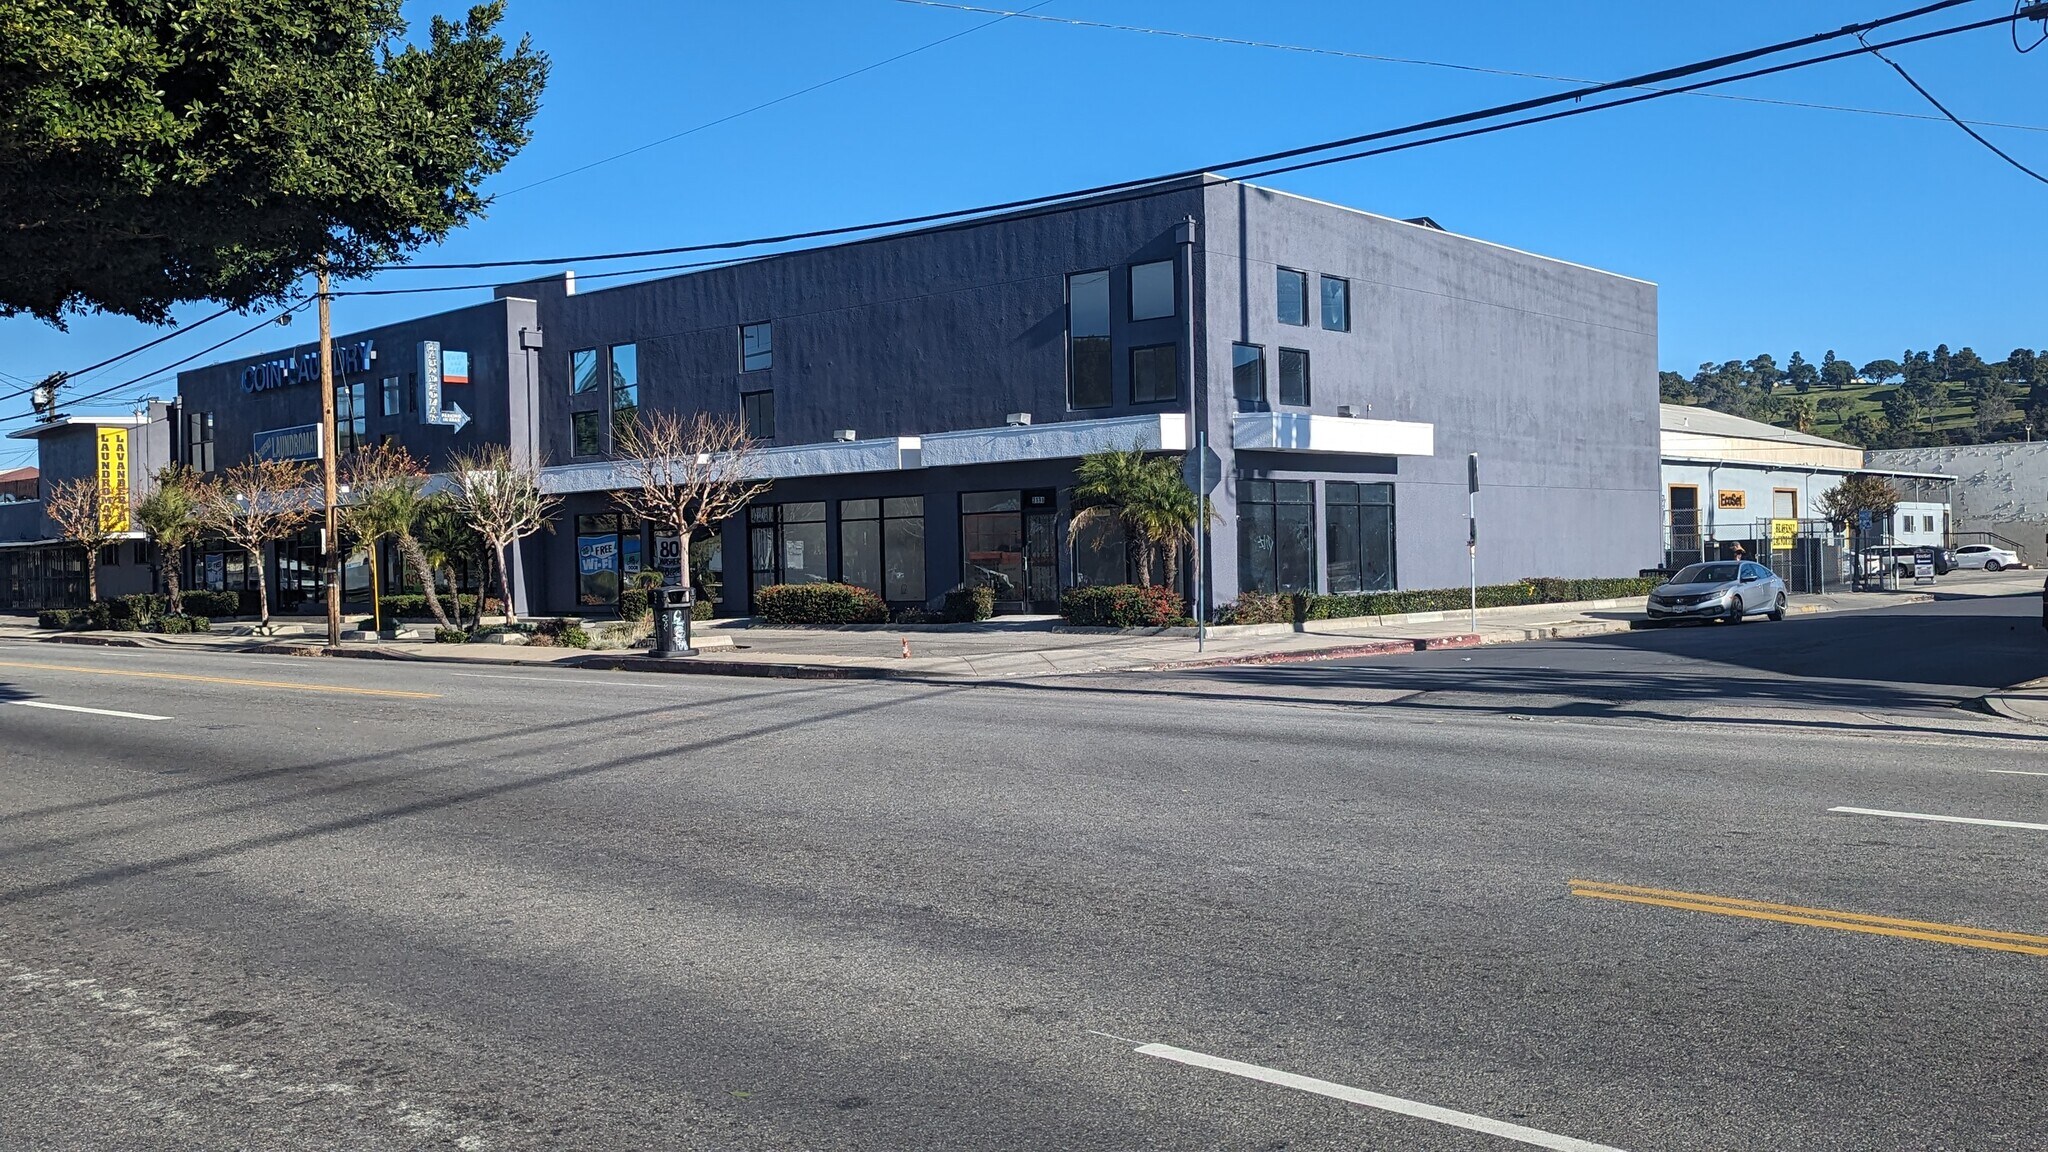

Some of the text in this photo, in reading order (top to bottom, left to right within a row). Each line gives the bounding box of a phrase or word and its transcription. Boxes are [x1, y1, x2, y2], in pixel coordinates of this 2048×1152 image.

[241, 340, 374, 393] COIN LAUDRY
[271, 432, 319, 459] LAUNDROMAT
[1721, 493, 1742, 506] EcoSet
[595, 545, 613, 556] FREE
[660, 541, 680, 557] 80
[582, 556, 613, 571] Wi-Fi
